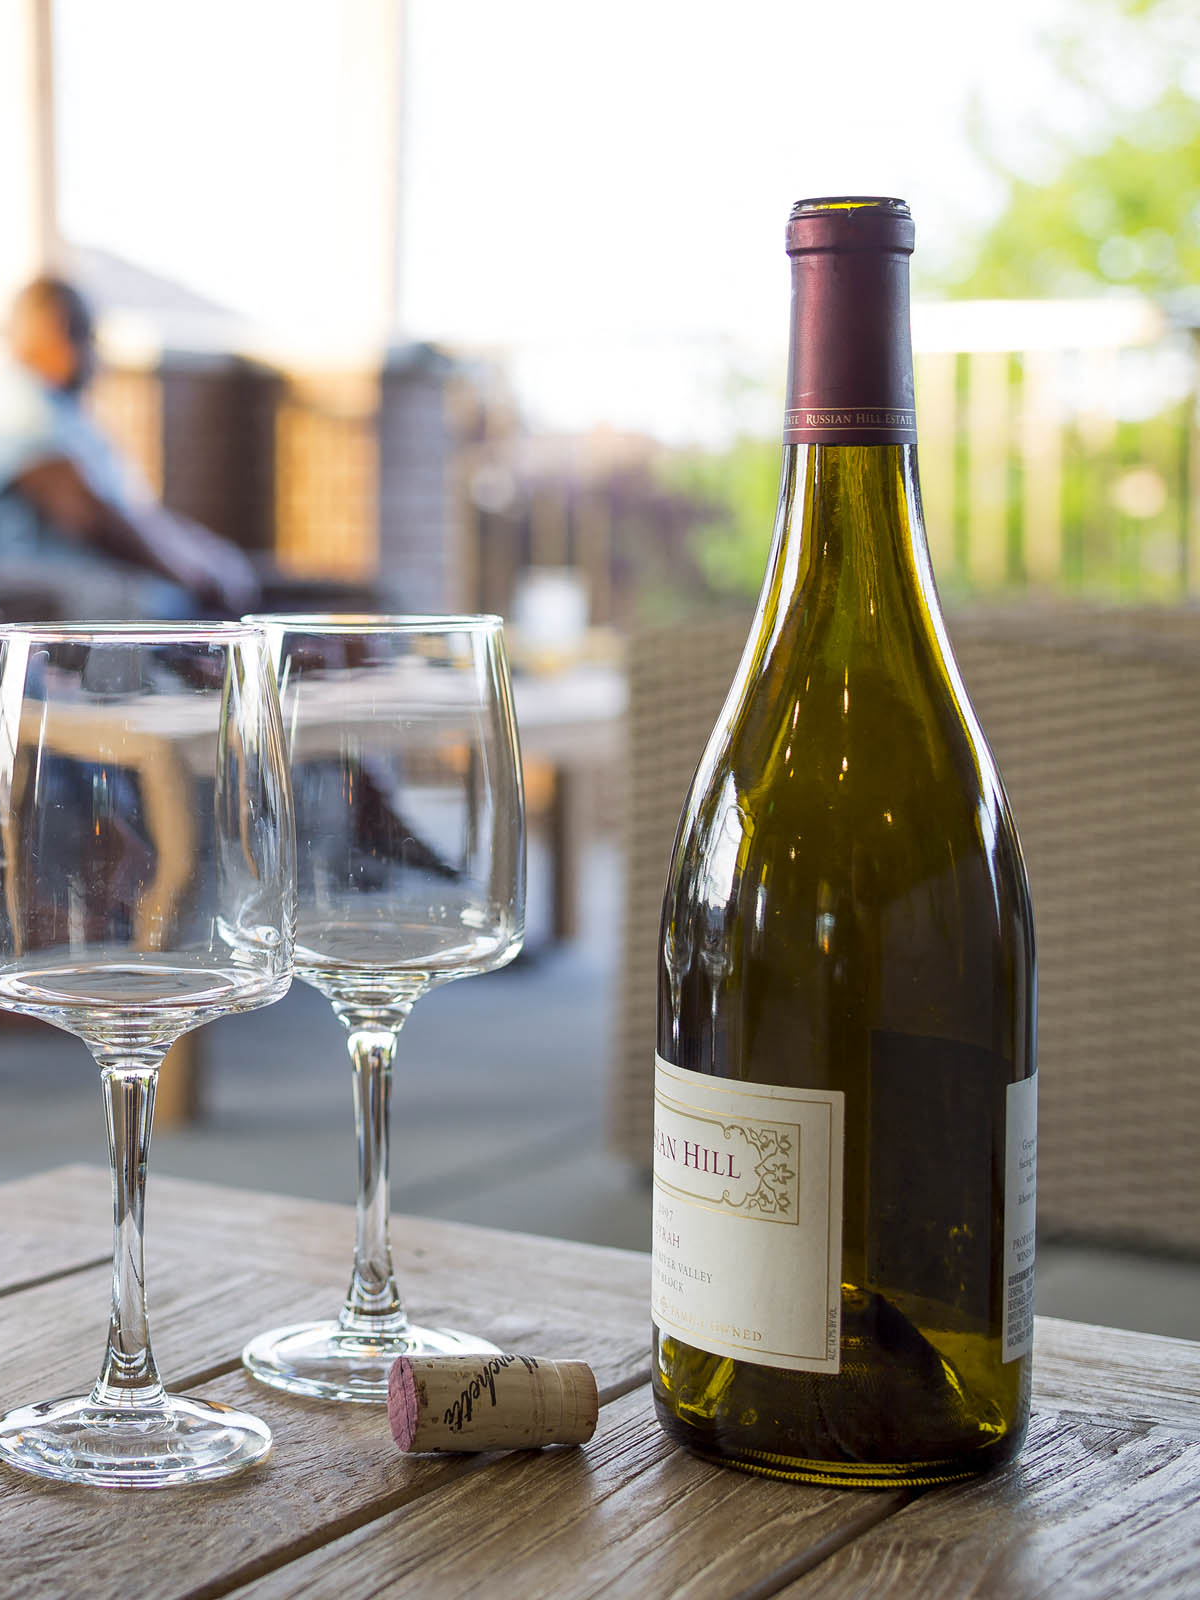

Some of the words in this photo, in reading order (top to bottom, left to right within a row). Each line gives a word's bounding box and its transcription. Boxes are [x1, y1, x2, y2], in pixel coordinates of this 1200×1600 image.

[806, 413, 851, 426] RUSSIAN
[856, 413, 882, 425] HILL
[885, 413, 913, 426] ESTATE
[683, 1140, 742, 1179] HILL
[679, 1262, 713, 1285] VALLEY
